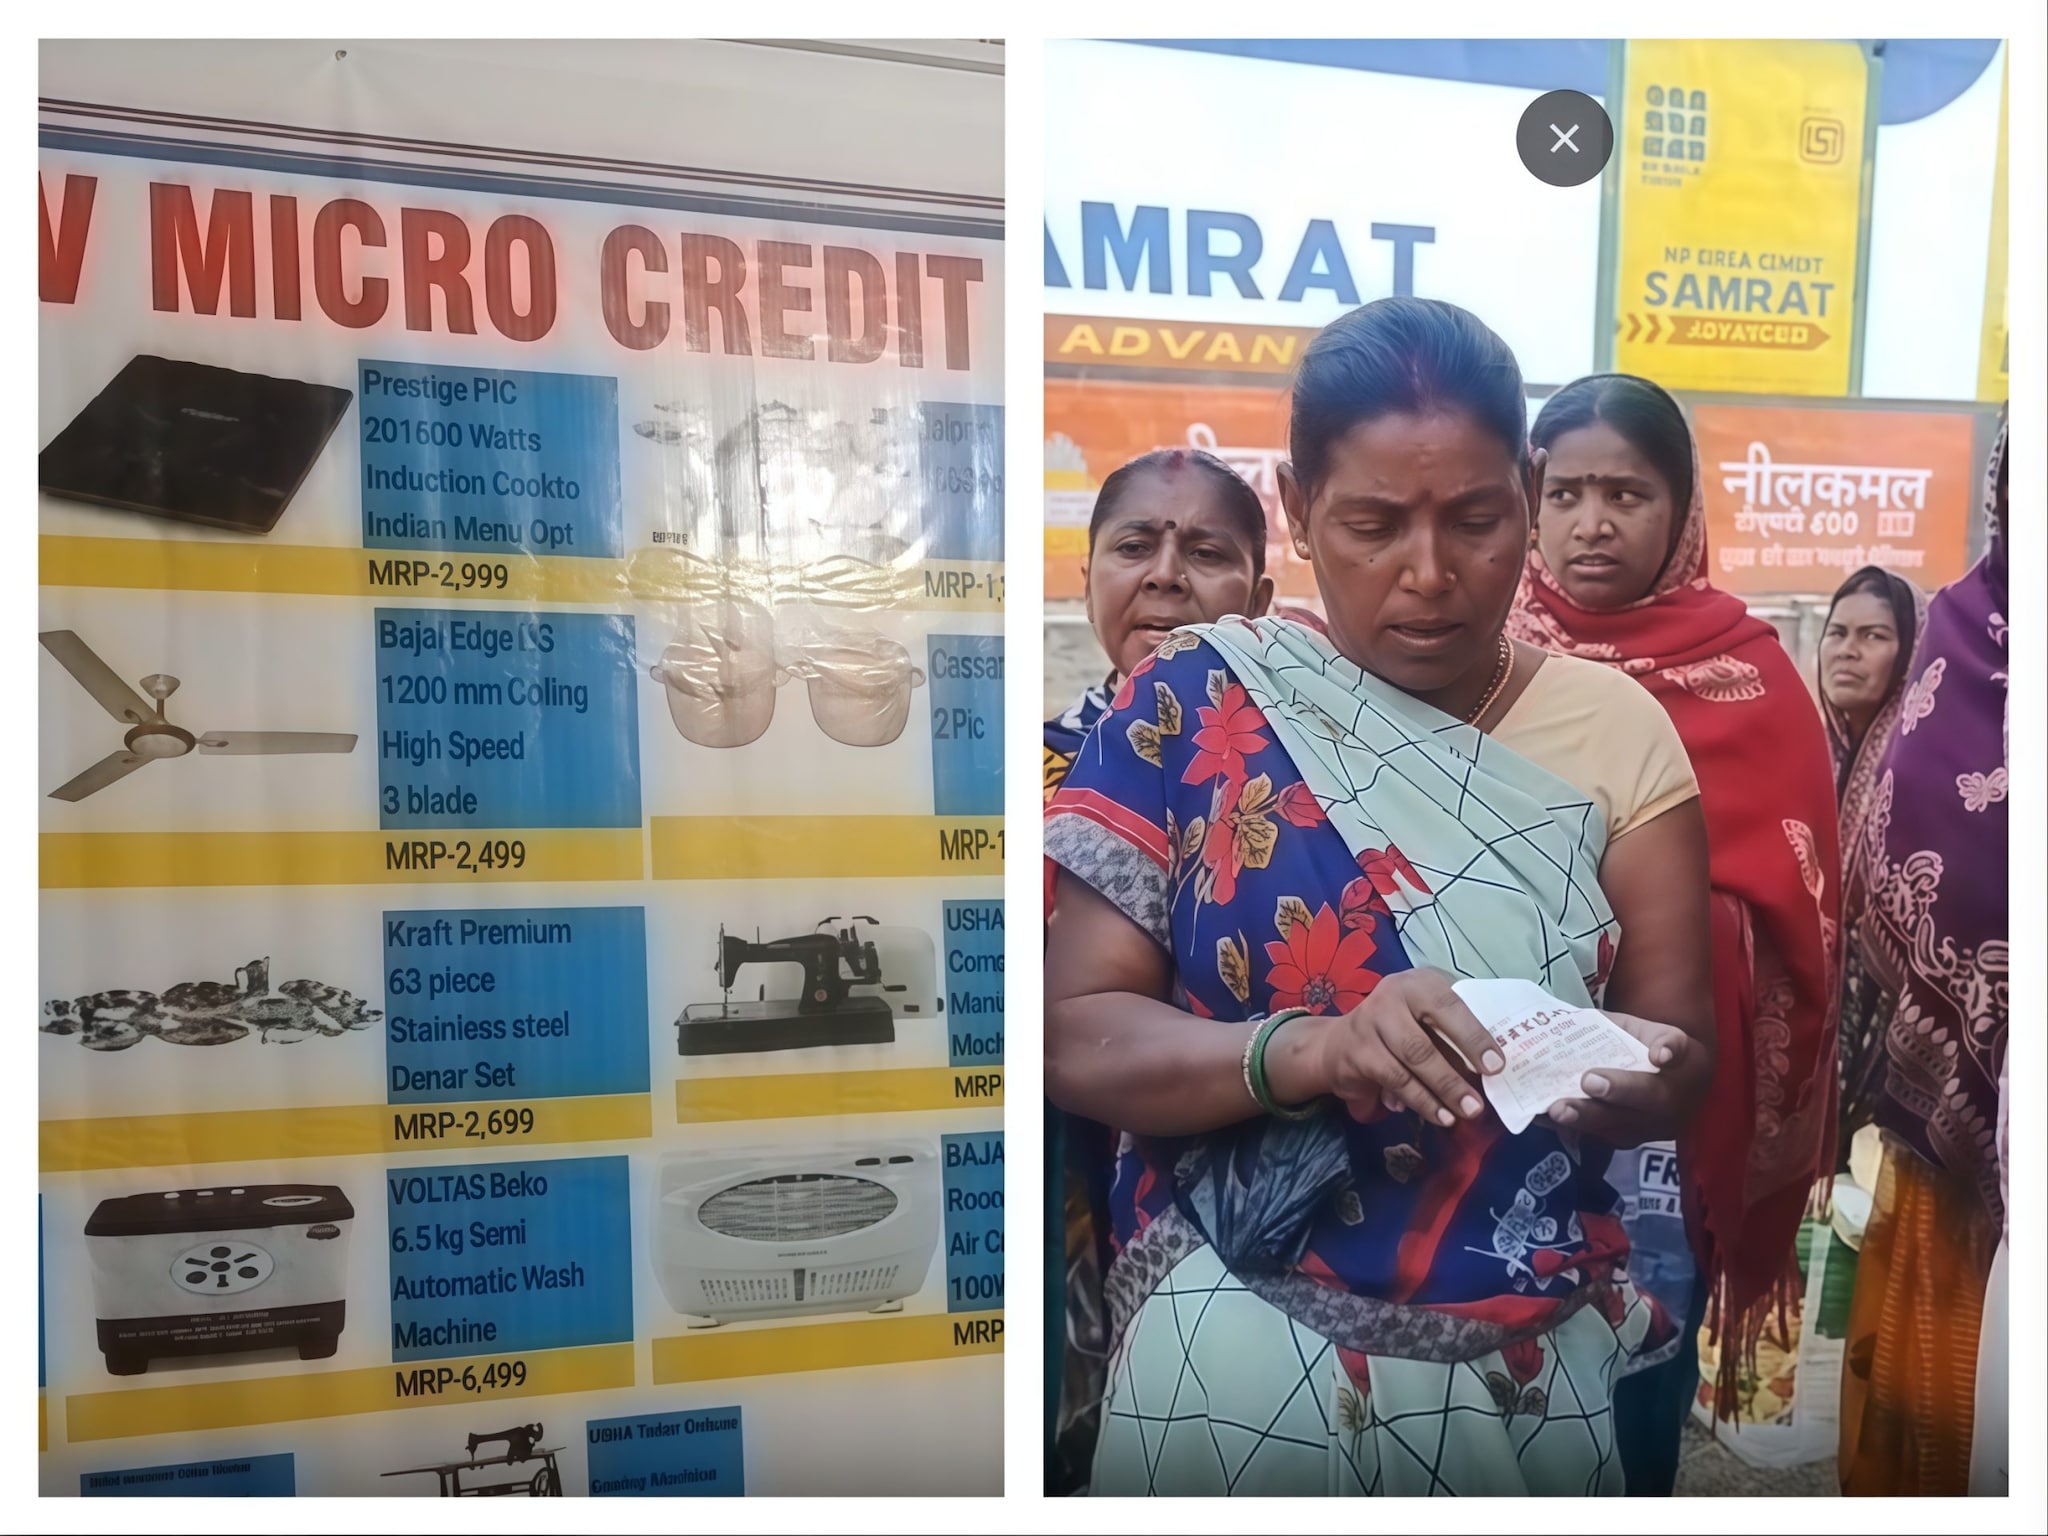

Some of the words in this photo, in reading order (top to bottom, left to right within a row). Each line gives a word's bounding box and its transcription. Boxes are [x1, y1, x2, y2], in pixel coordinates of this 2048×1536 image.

[149, 181, 558, 343] MICRO
[600, 224, 984, 371] CREDIT
[1643, 270, 1835, 318] SAMRAT
[1058, 323, 1296, 365] ADVAN
[364, 369, 468, 406] Prestige
[473, 377, 517, 404] PIC
[468, 423, 542, 452] Watts
[366, 463, 485, 495] Induction
[492, 470, 580, 500] Cookto
[1719, 441, 1933, 510] नीलकमल
[367, 511, 446, 540] Indian
[454, 515, 522, 543] Menu
[530, 519, 574, 549] Opt
[368, 559, 509, 591] MRP-2,999
[450, 620, 513, 658] Edge
[382, 674, 447, 705] 1200
[453, 682, 502, 705] mm
[507, 676, 589, 713] Coling
[934, 707, 949, 739] 2
[952, 707, 985, 739] Pic
[382, 729, 441, 767] High
[448, 730, 525, 767] Speed
[383, 785, 400, 815] 3
[407, 784, 478, 815] blade
[385, 840, 526, 874] MRP-2,499
[387, 918, 452, 947] Kraft
[460, 918, 572, 945] Premium
[946, 907, 1004, 932] USHA
[389, 967, 422, 995] 63
[429, 965, 496, 1001] piece
[512, 1010, 569, 1039] steel
[391, 1064, 468, 1092] Denar
[474, 1061, 516, 1089] Set
[393, 1107, 534, 1141] MRP-2,699
[946, 1141, 1004, 1168] BAJA
[389, 1173, 486, 1206] VOLTAS
[490, 1170, 548, 1199] Beko
[391, 1224, 431, 1253] 6.5
[435, 1223, 463, 1255] kg
[469, 1218, 526, 1248] Semi
[950, 1231, 980, 1257] Air
[985, 1229, 1004, 1255] C
[393, 1266, 517, 1301] Automatic
[521, 1261, 585, 1292] Wash
[394, 1317, 497, 1350] Machine
[395, 1360, 527, 1398] MRP-6,499
